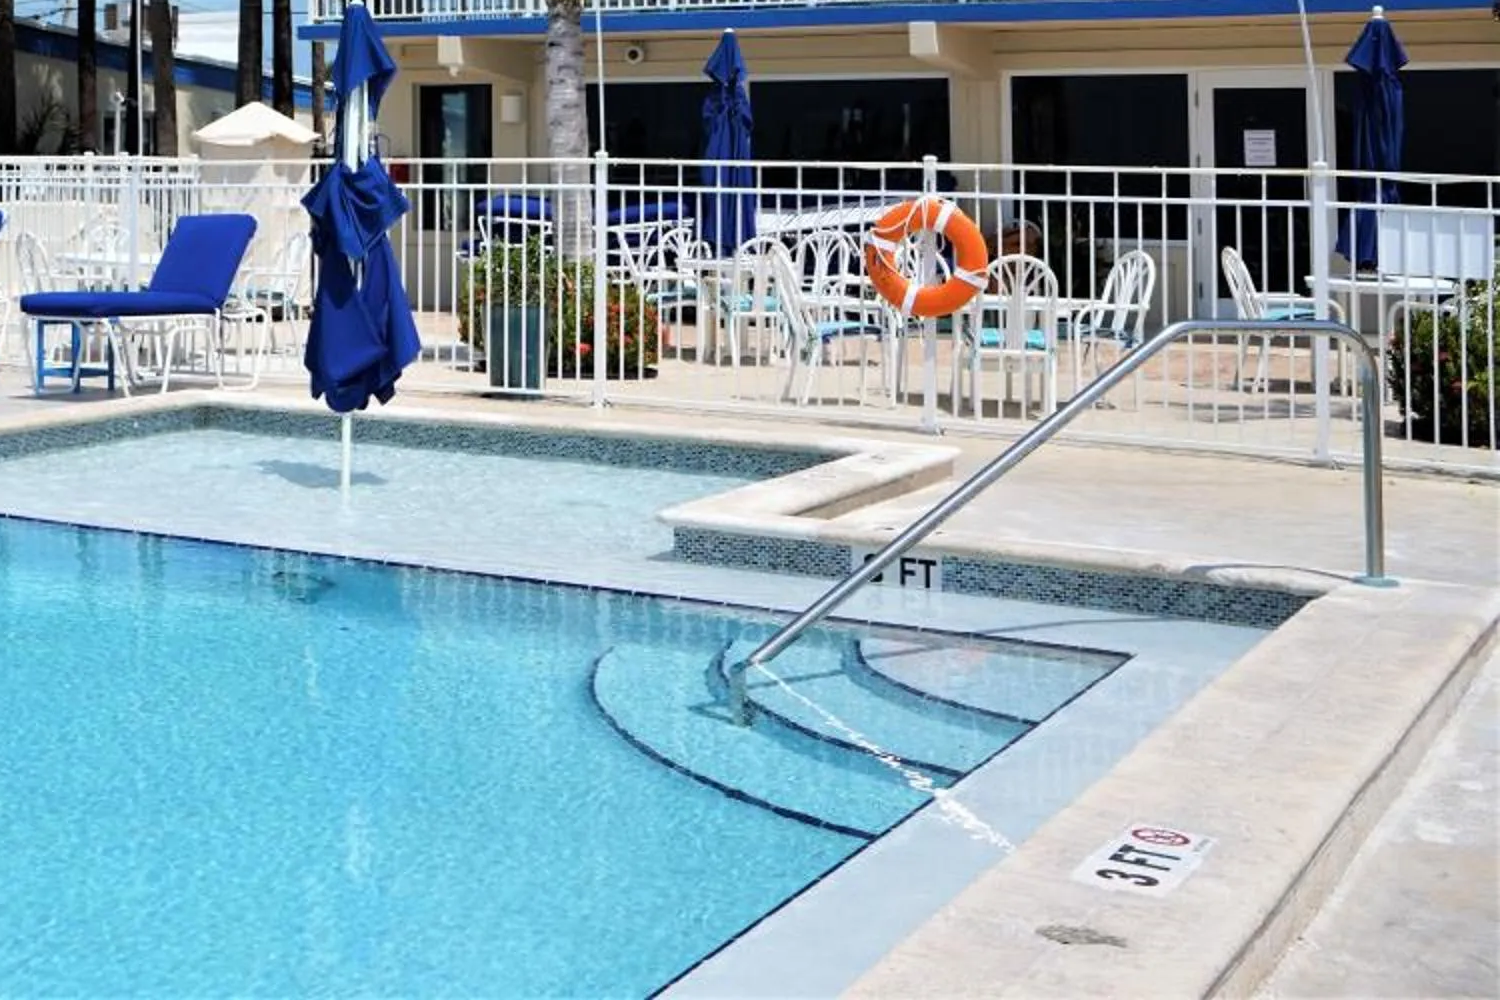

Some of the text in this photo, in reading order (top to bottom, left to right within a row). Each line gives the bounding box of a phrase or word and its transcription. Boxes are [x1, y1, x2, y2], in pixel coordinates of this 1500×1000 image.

[899, 557, 937, 589] FT
[1096, 843, 1181, 887] 3 FT
